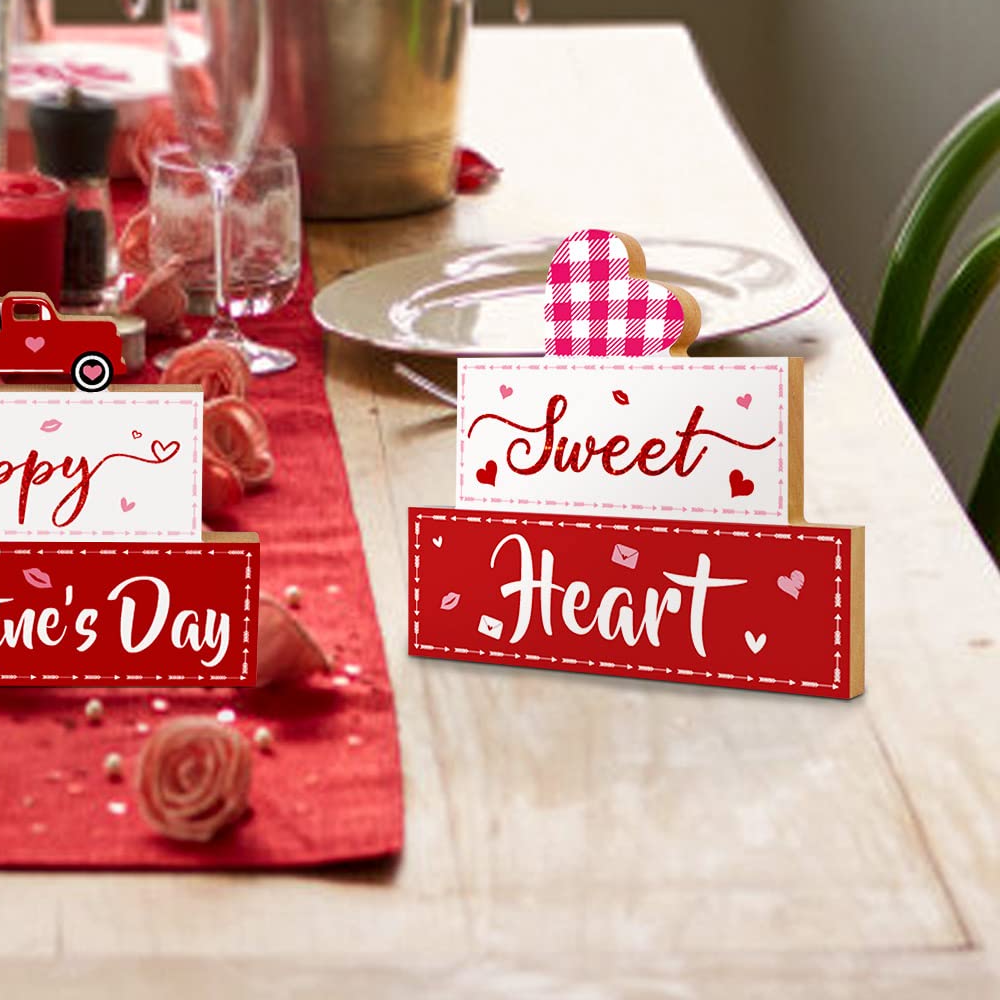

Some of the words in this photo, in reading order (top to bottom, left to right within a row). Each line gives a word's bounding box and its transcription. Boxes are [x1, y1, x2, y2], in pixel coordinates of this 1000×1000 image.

[468, 394, 776, 477] Sweet
[107, 576, 231, 667] Day
[490, 533, 748, 658] Heart
